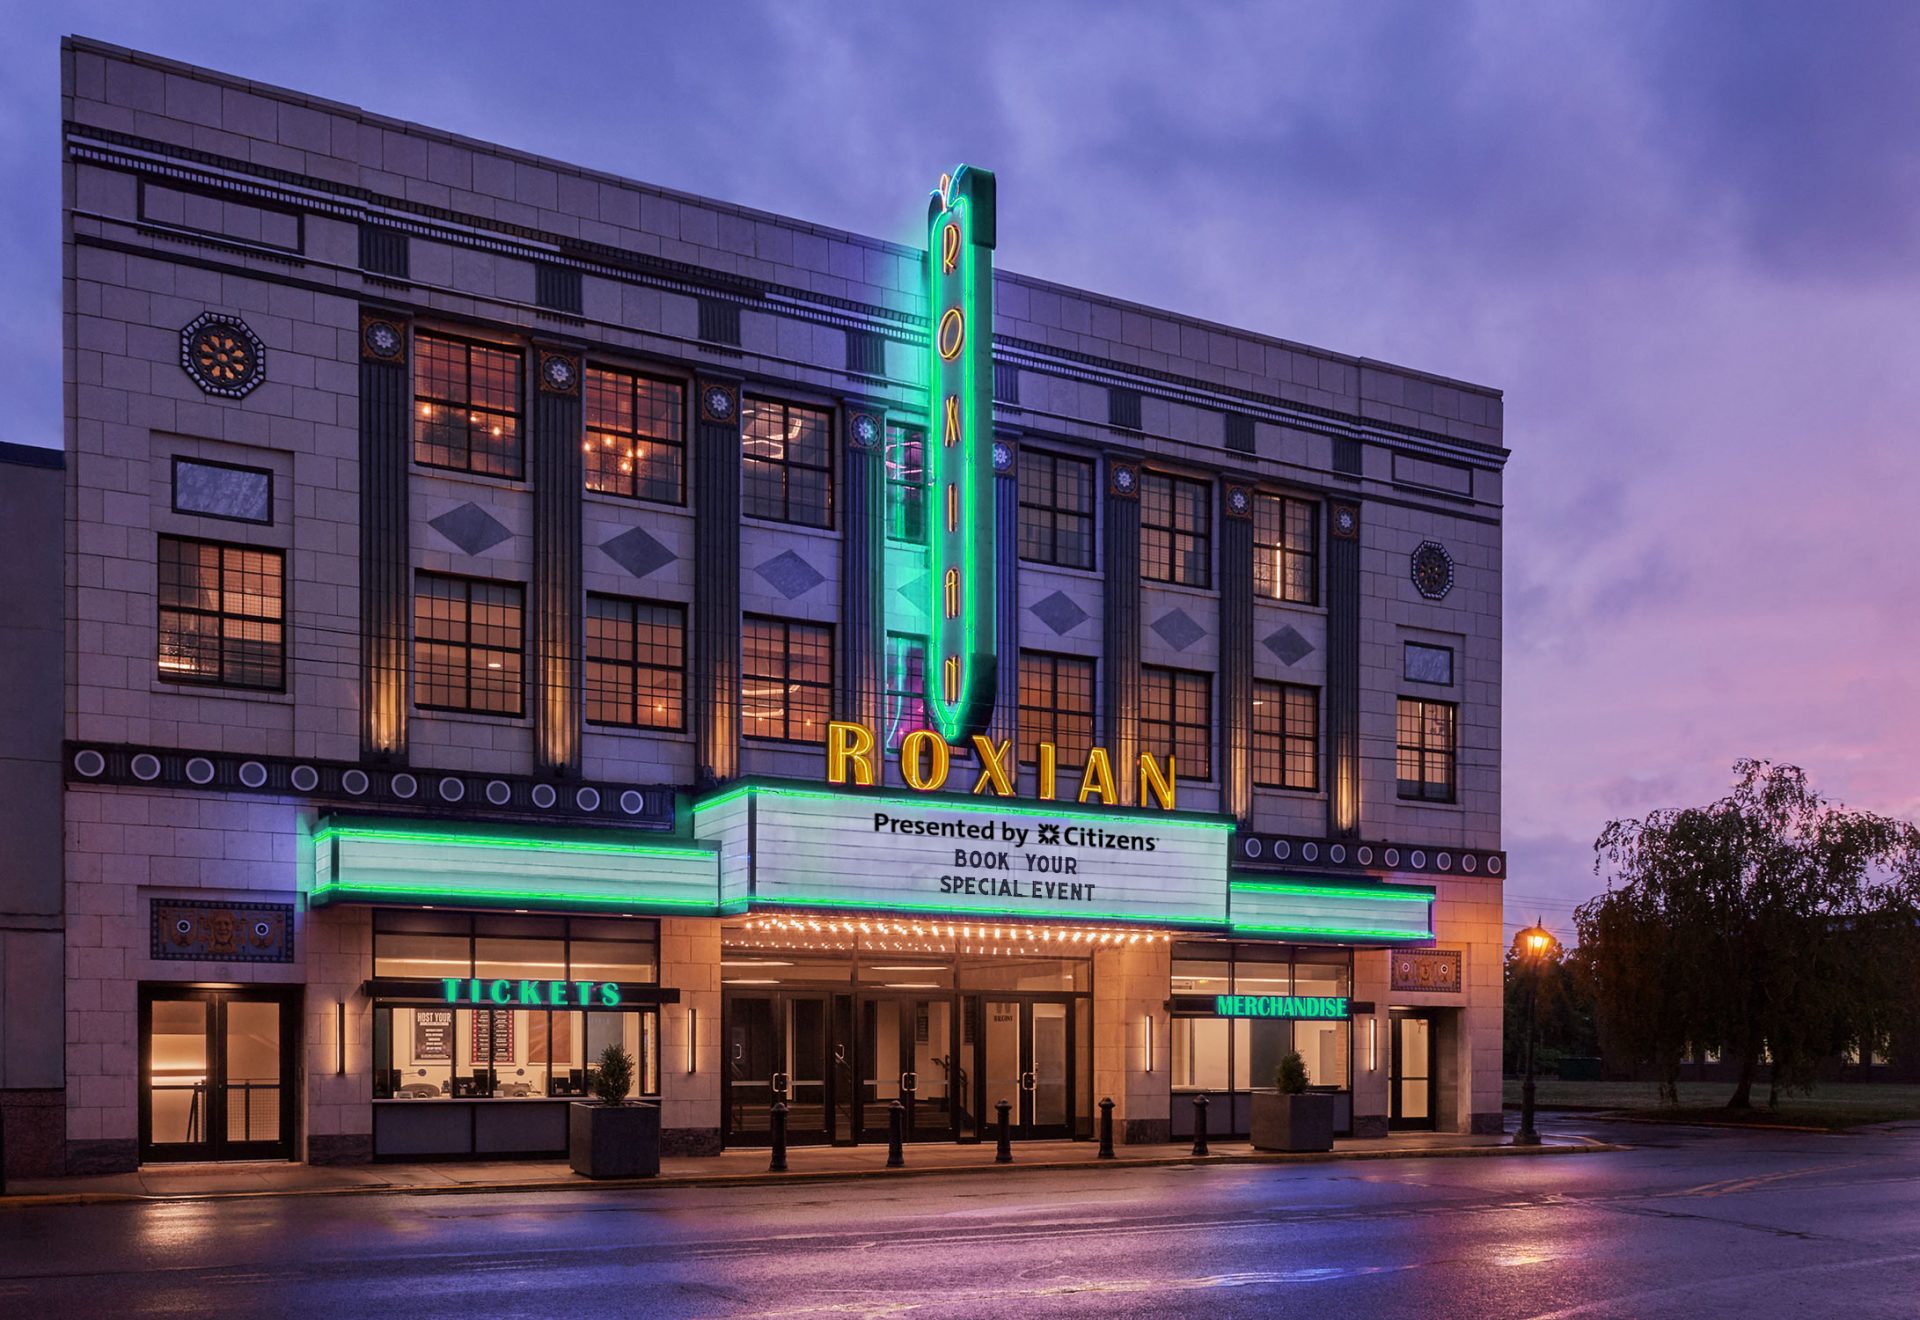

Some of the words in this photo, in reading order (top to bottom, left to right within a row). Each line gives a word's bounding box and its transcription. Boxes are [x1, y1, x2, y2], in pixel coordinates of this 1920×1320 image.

[936, 222, 967, 707] ROXIAN
[828, 721, 1176, 810] ROXIAN
[873, 812, 995, 841] Presented
[1001, 818, 1029, 848] by
[1063, 827, 1157, 852] Citizens
[954, 849, 1010, 871] BOOK
[1025, 853, 1078, 875] YOUR
[940, 875, 1021, 897] SPECIAL
[1031, 880, 1096, 902] EVENT
[443, 978, 620, 1006] TICKETS
[417, 1012, 434, 1023] HOST
[434, 1012, 451, 1023] YOUR
[1217, 995, 1348, 1018] MERCHANDISE
